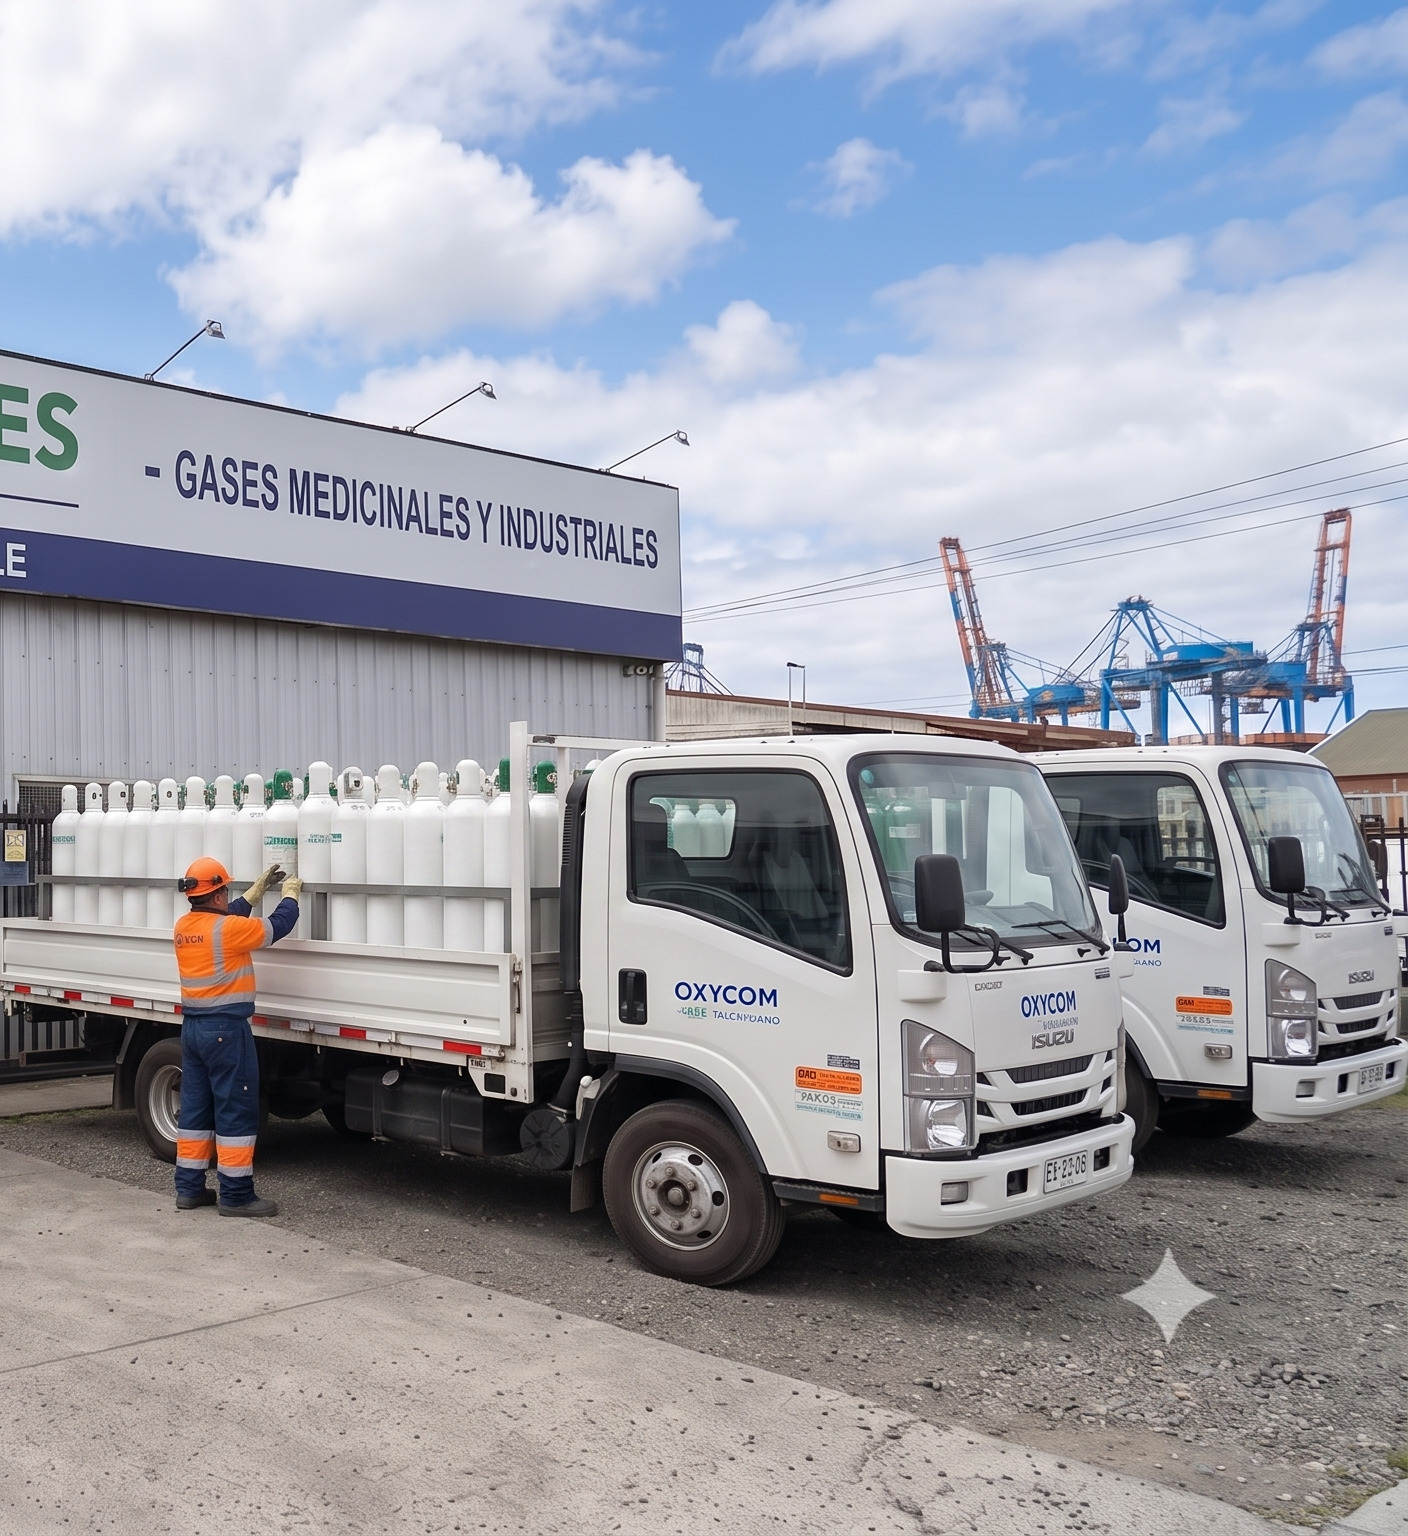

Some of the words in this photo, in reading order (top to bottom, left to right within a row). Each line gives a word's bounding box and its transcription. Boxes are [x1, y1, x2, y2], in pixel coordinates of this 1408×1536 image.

[175, 450, 279, 512] GASES
[289, 468, 471, 541] MEDICINALES
[476, 501, 493, 543] Y
[499, 504, 659, 570] INDUSTRIALES
[674, 981, 778, 1007] OXYCOM
[1021, 990, 1077, 1018] OXYCOM
[1031, 1029, 1075, 1049] ISUZU
